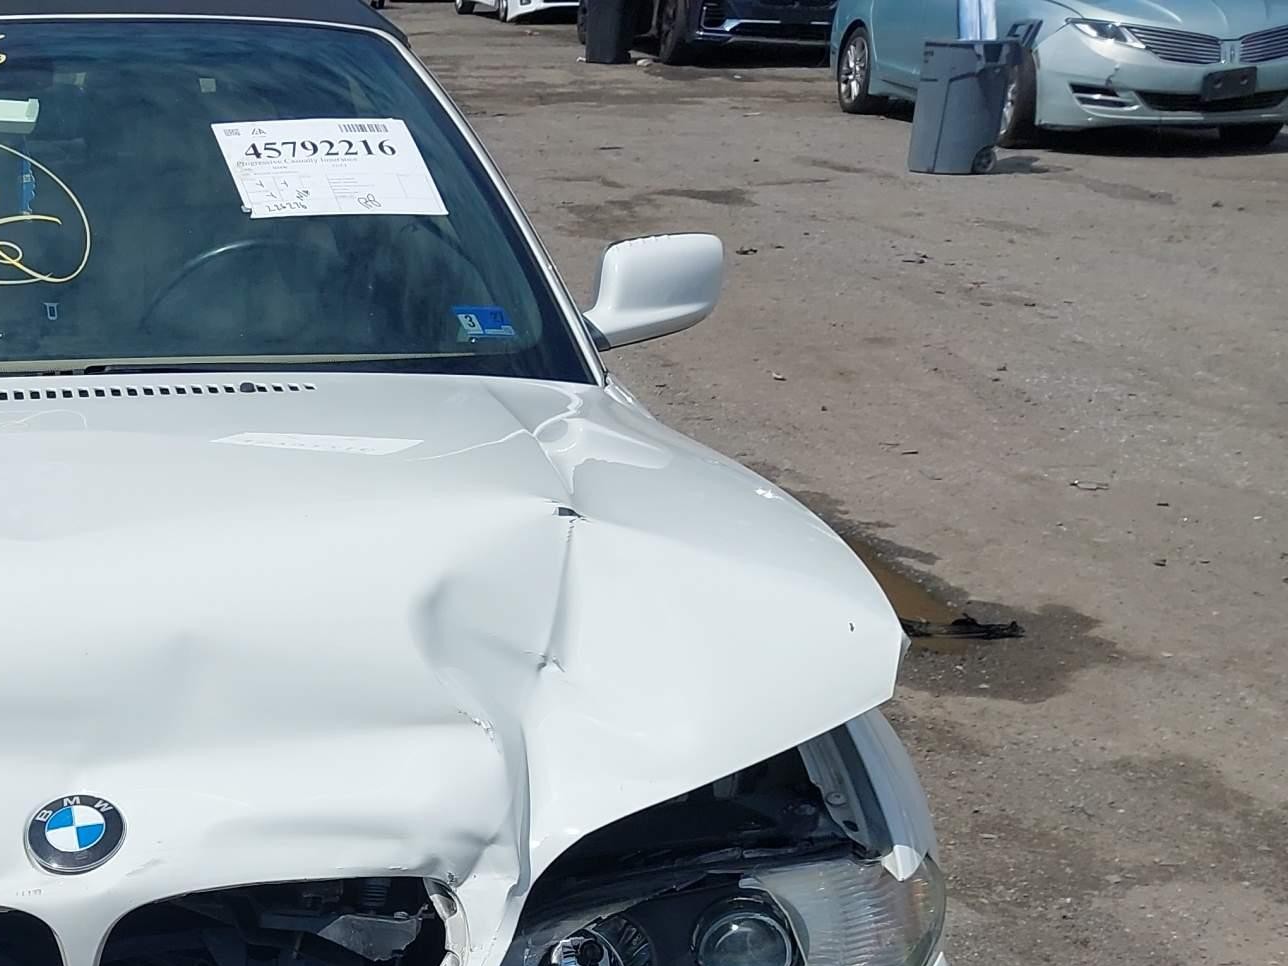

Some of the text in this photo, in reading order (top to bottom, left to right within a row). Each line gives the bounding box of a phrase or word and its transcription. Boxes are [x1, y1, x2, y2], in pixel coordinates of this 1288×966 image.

[244, 139, 397, 159] 45792216
[464, 314, 476, 328] 3
[35, 796, 114, 822] BMW
